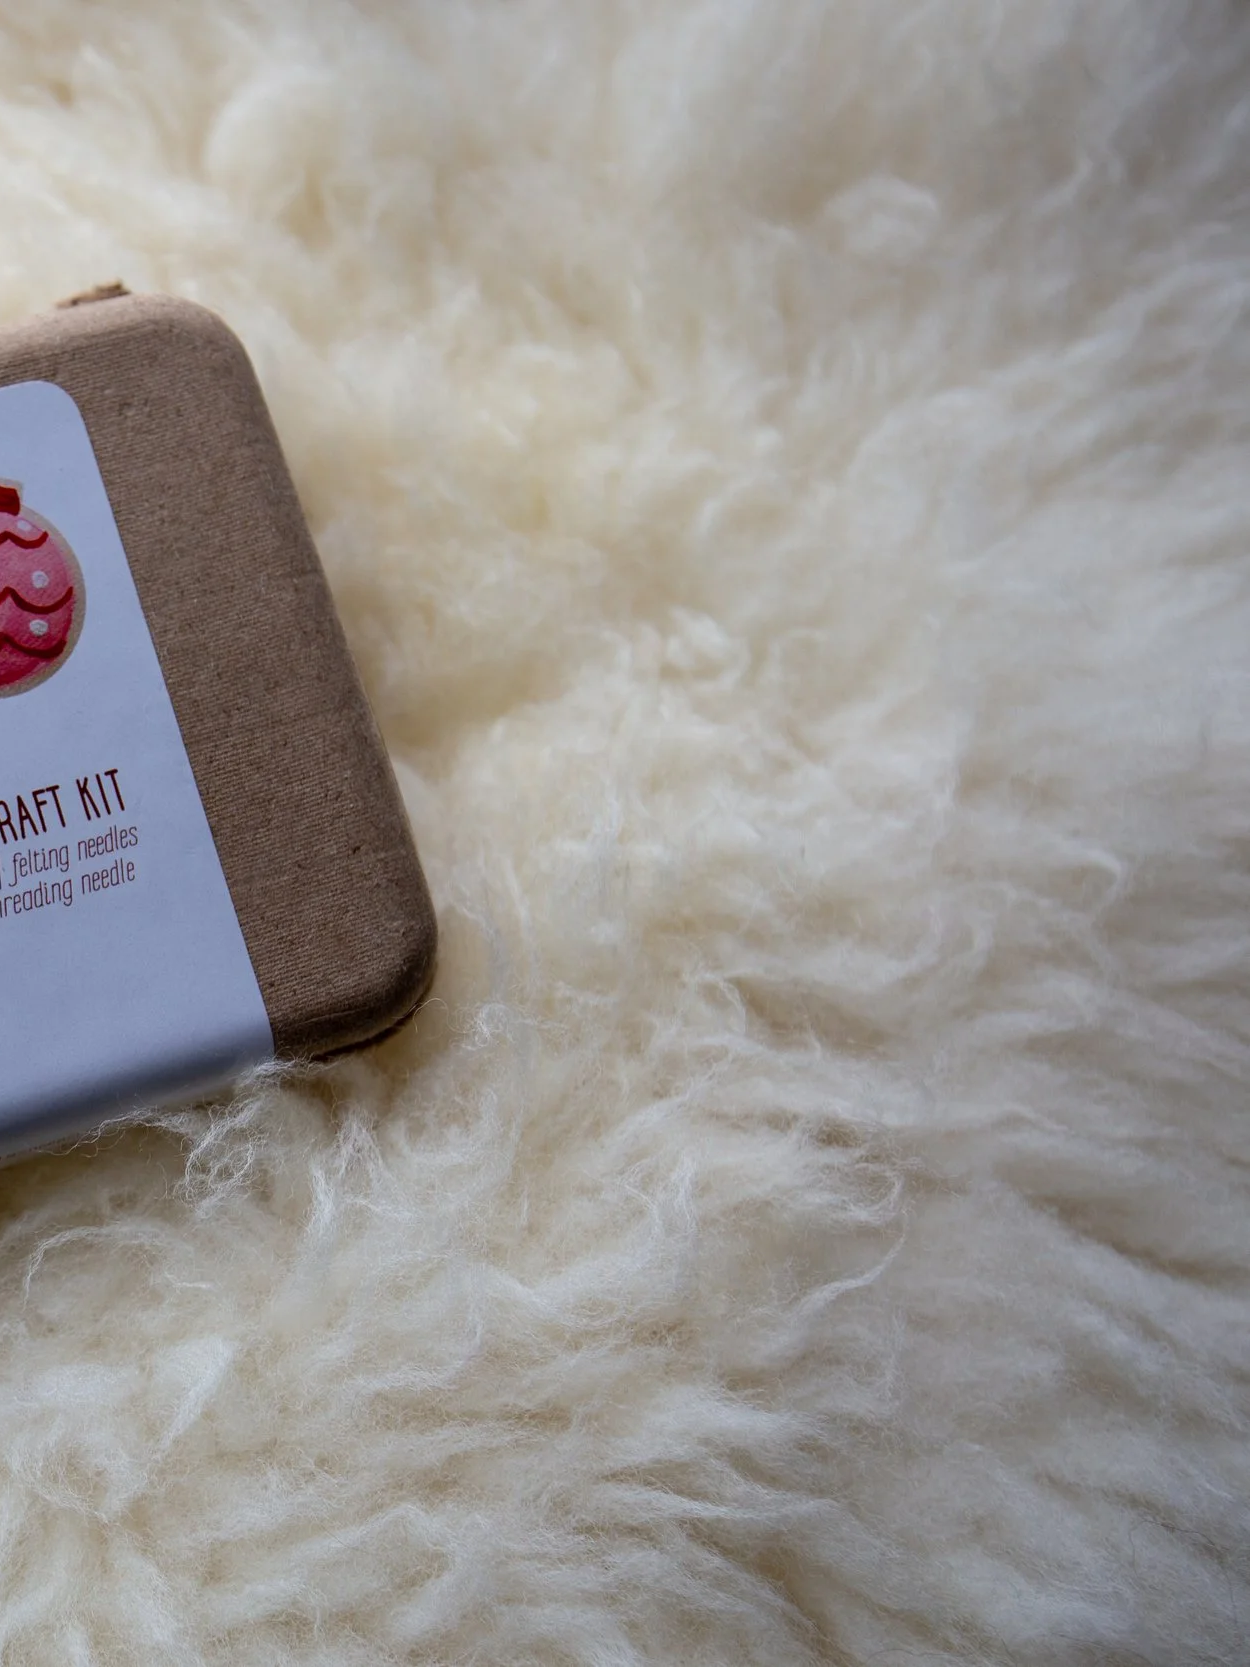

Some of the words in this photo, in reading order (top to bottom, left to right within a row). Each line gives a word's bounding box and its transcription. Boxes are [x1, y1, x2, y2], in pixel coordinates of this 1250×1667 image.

[76, 768, 125, 821] KIT
[8, 844, 69, 888] felting
[77, 825, 139, 861] needles
[81, 858, 136, 896] needle
